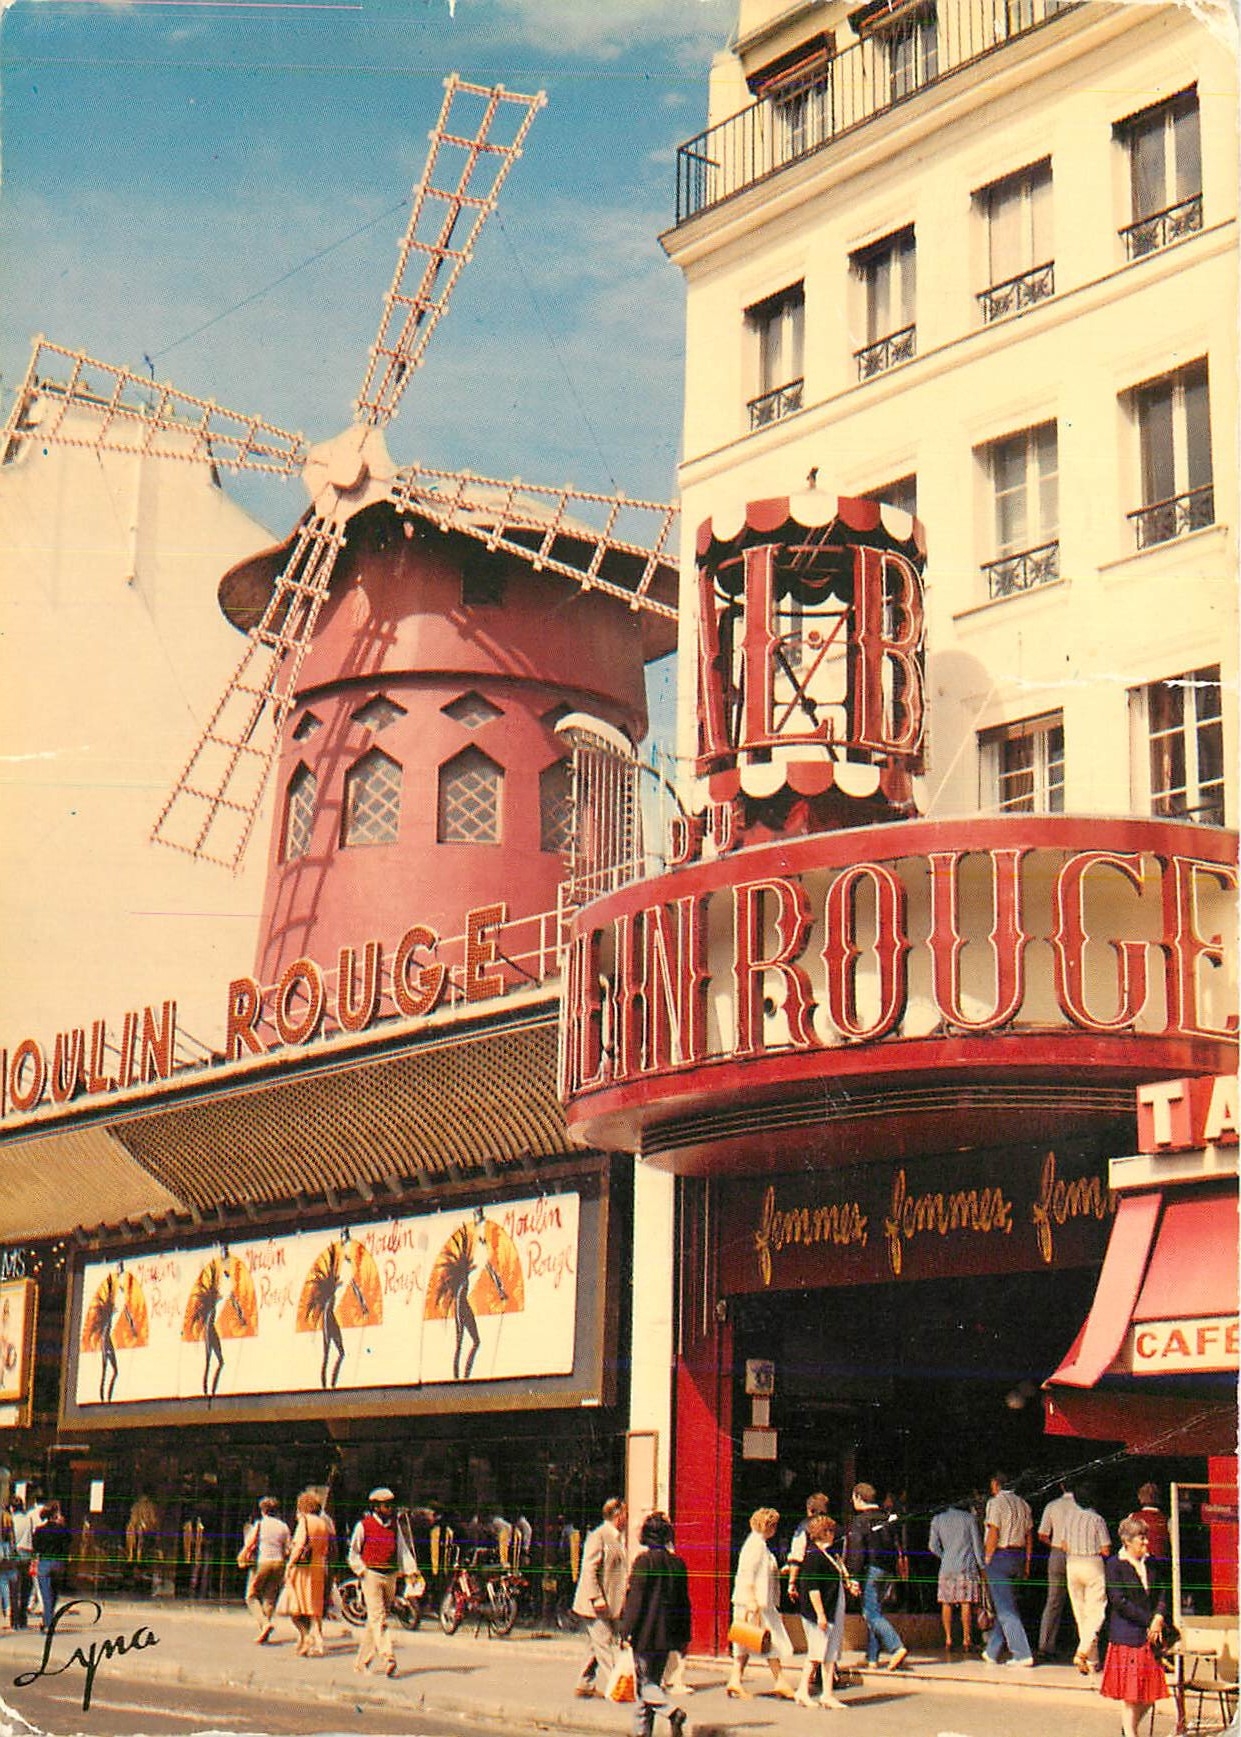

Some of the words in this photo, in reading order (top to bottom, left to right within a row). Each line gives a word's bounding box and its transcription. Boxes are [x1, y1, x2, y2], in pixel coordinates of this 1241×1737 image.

[0, 1000, 177, 1118] OULIN
[226, 902, 507, 1061] ROUGE
[730, 848, 1239, 1056] ROUGE
[503, 1196, 562, 1239] Moulin
